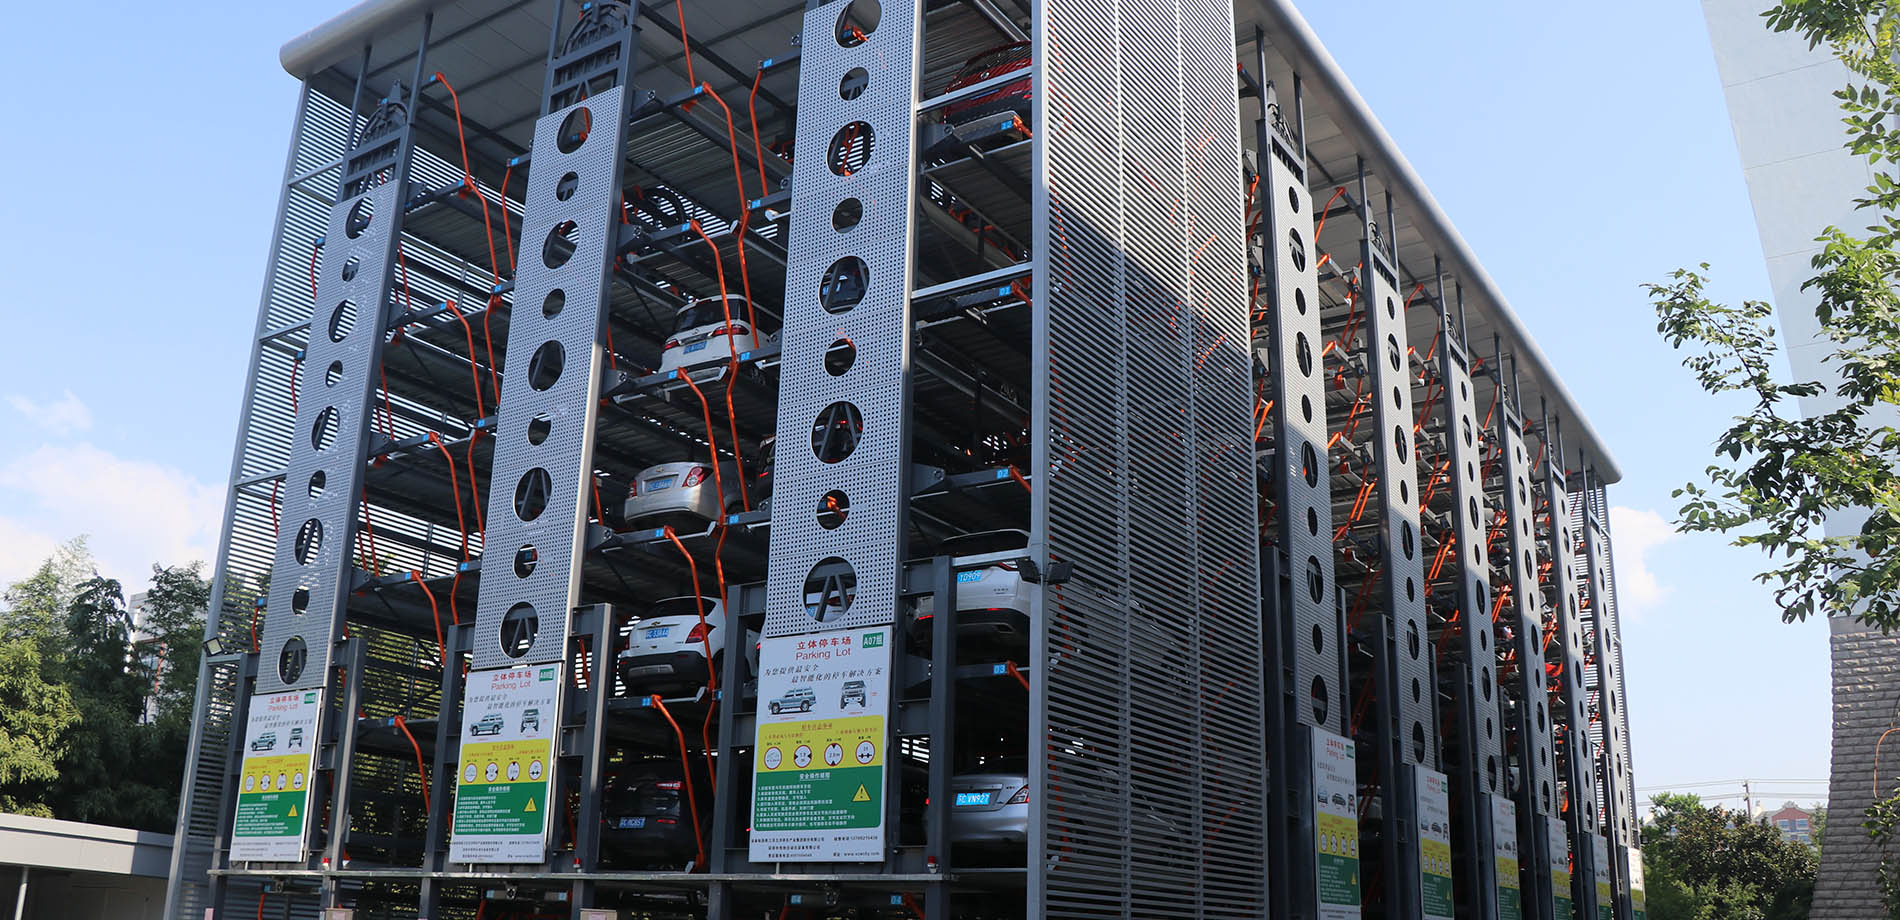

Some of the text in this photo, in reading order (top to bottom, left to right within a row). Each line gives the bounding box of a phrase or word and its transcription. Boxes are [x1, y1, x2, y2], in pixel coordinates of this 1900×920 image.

[797, 636, 851, 650] 立体停车场
[795, 648, 851, 660] Parking Lot
[993, 664, 1006, 675] 03
